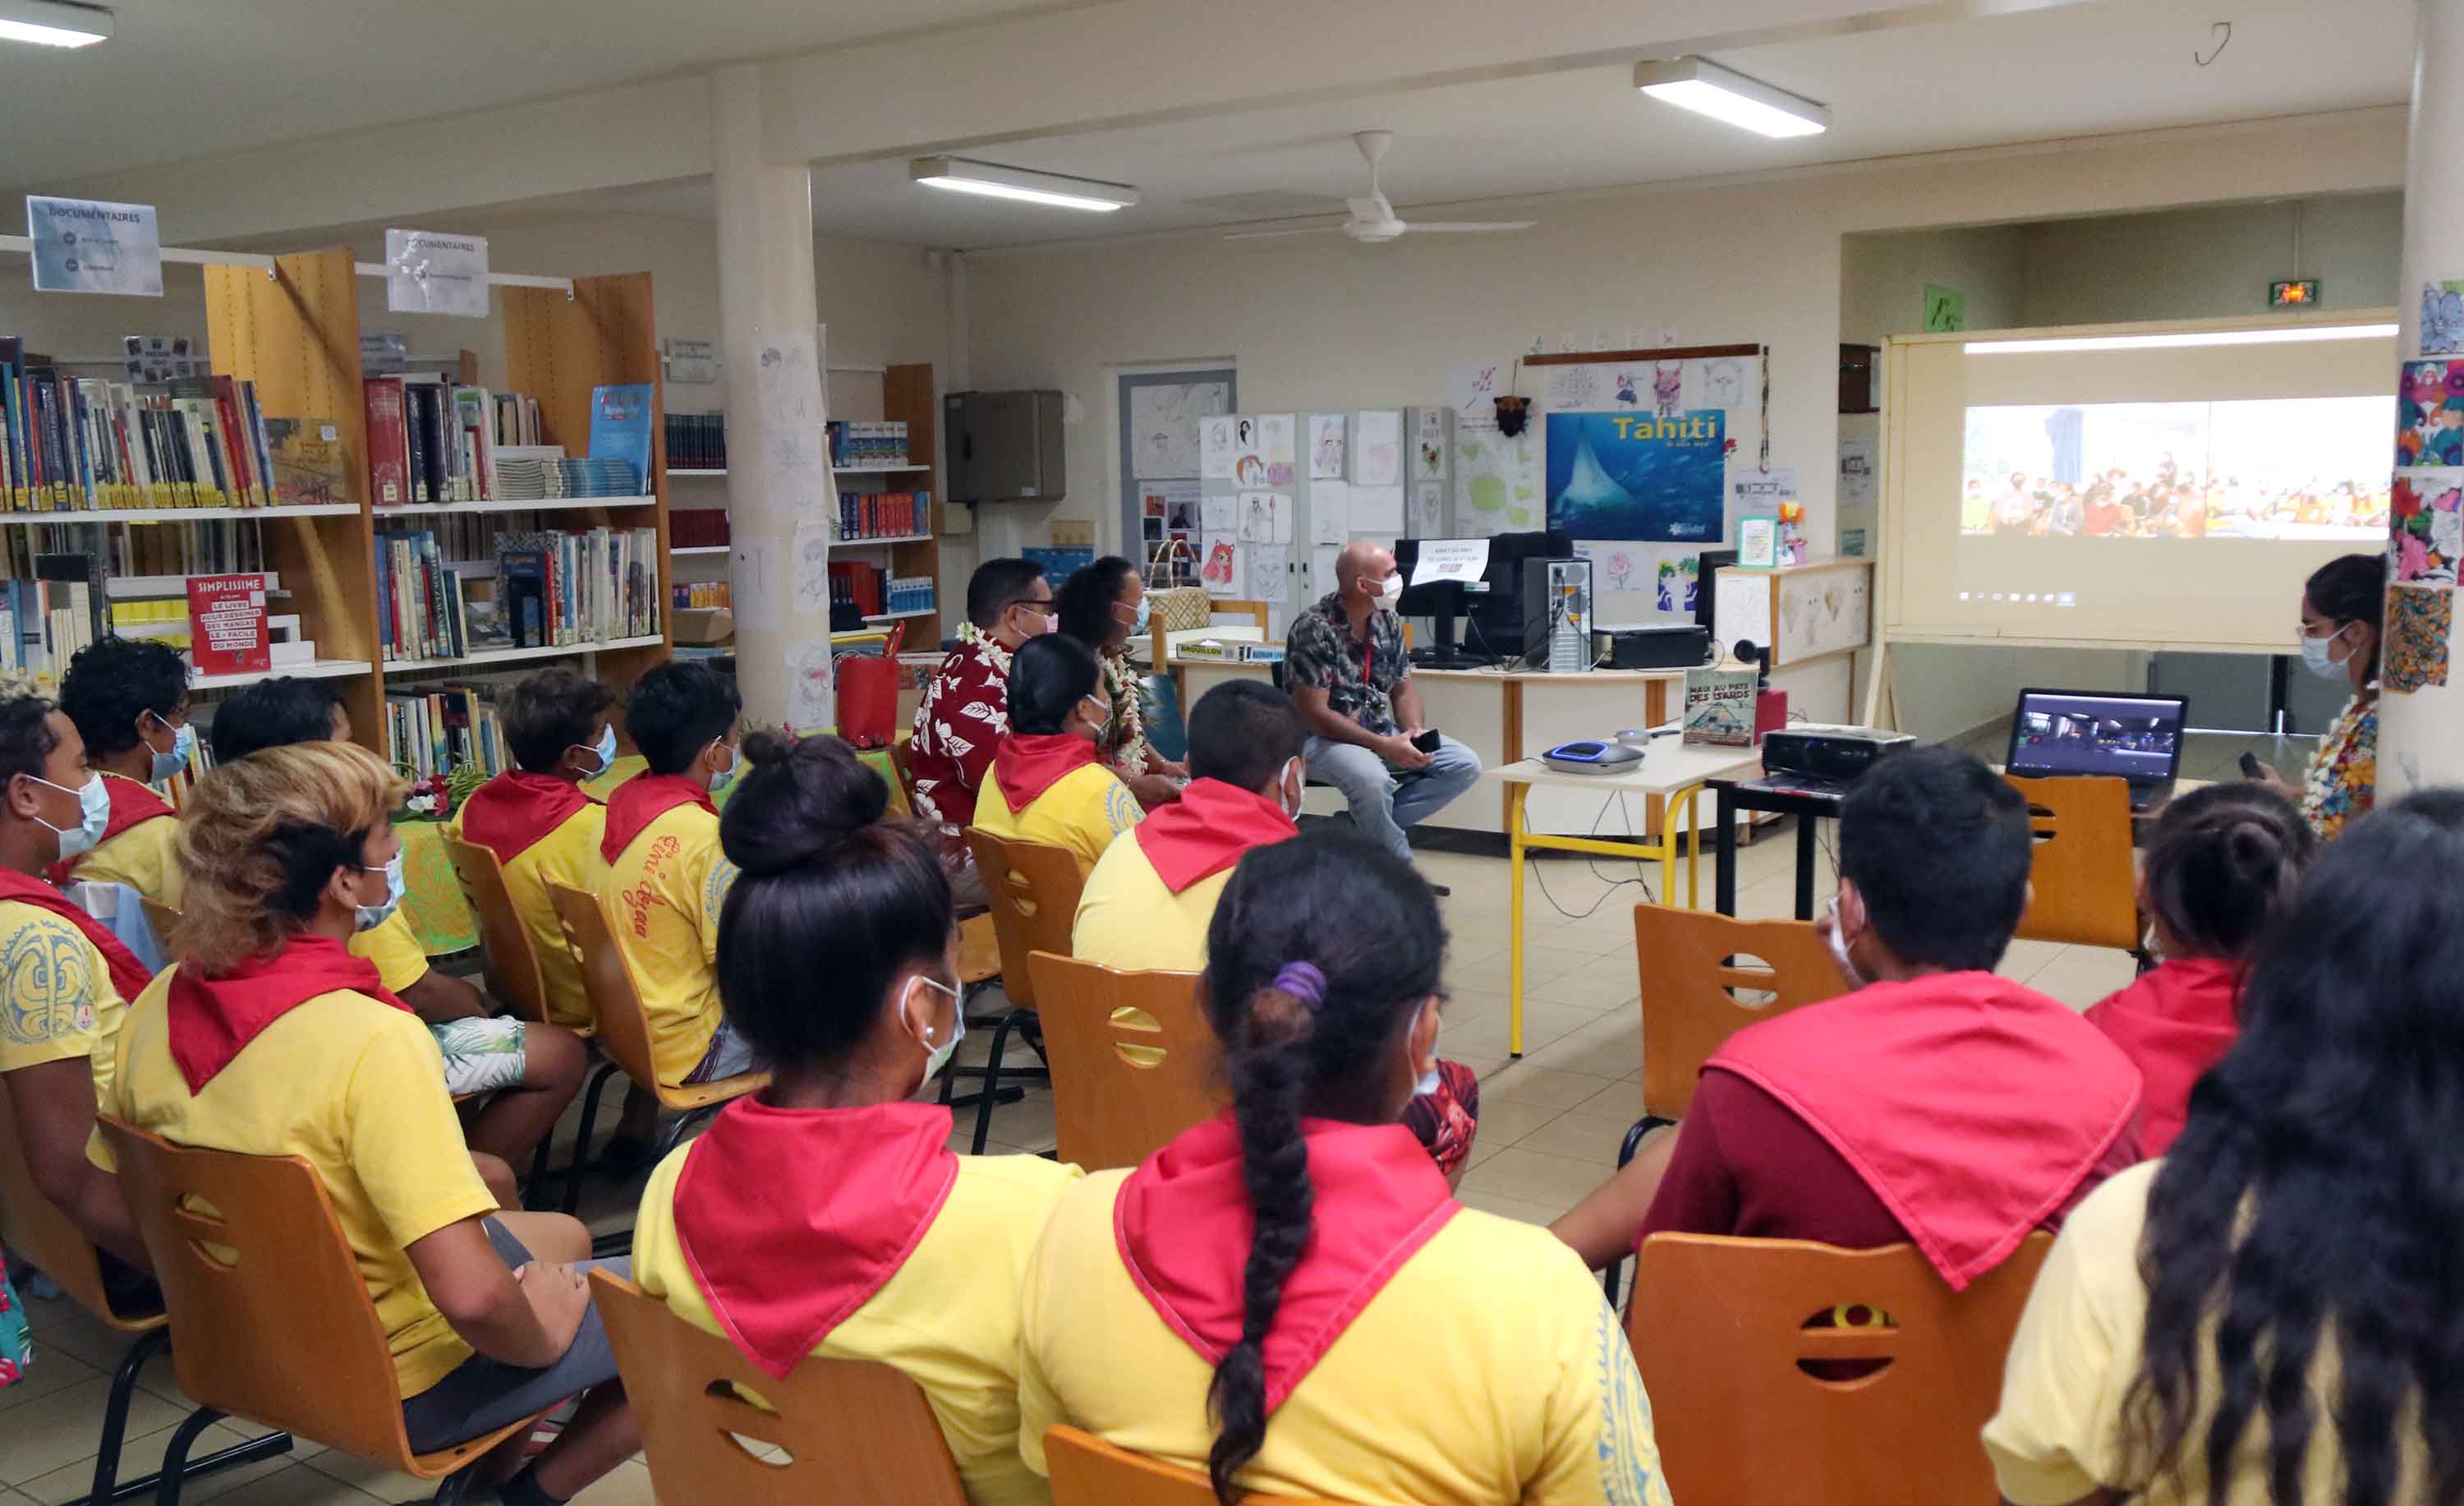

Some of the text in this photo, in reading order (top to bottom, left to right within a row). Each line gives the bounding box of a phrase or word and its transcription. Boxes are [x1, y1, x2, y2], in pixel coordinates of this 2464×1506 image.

[48, 207, 140, 223] DOCUMENTAIRES
[1612, 416, 1716, 440] Tahiti
[198, 579, 261, 592] SIMPLISSIME
[226, 640, 255, 648] MONDE
[1181, 645, 1222, 655] BROUILLON
[1689, 690, 1749, 702] DES ISARDS
